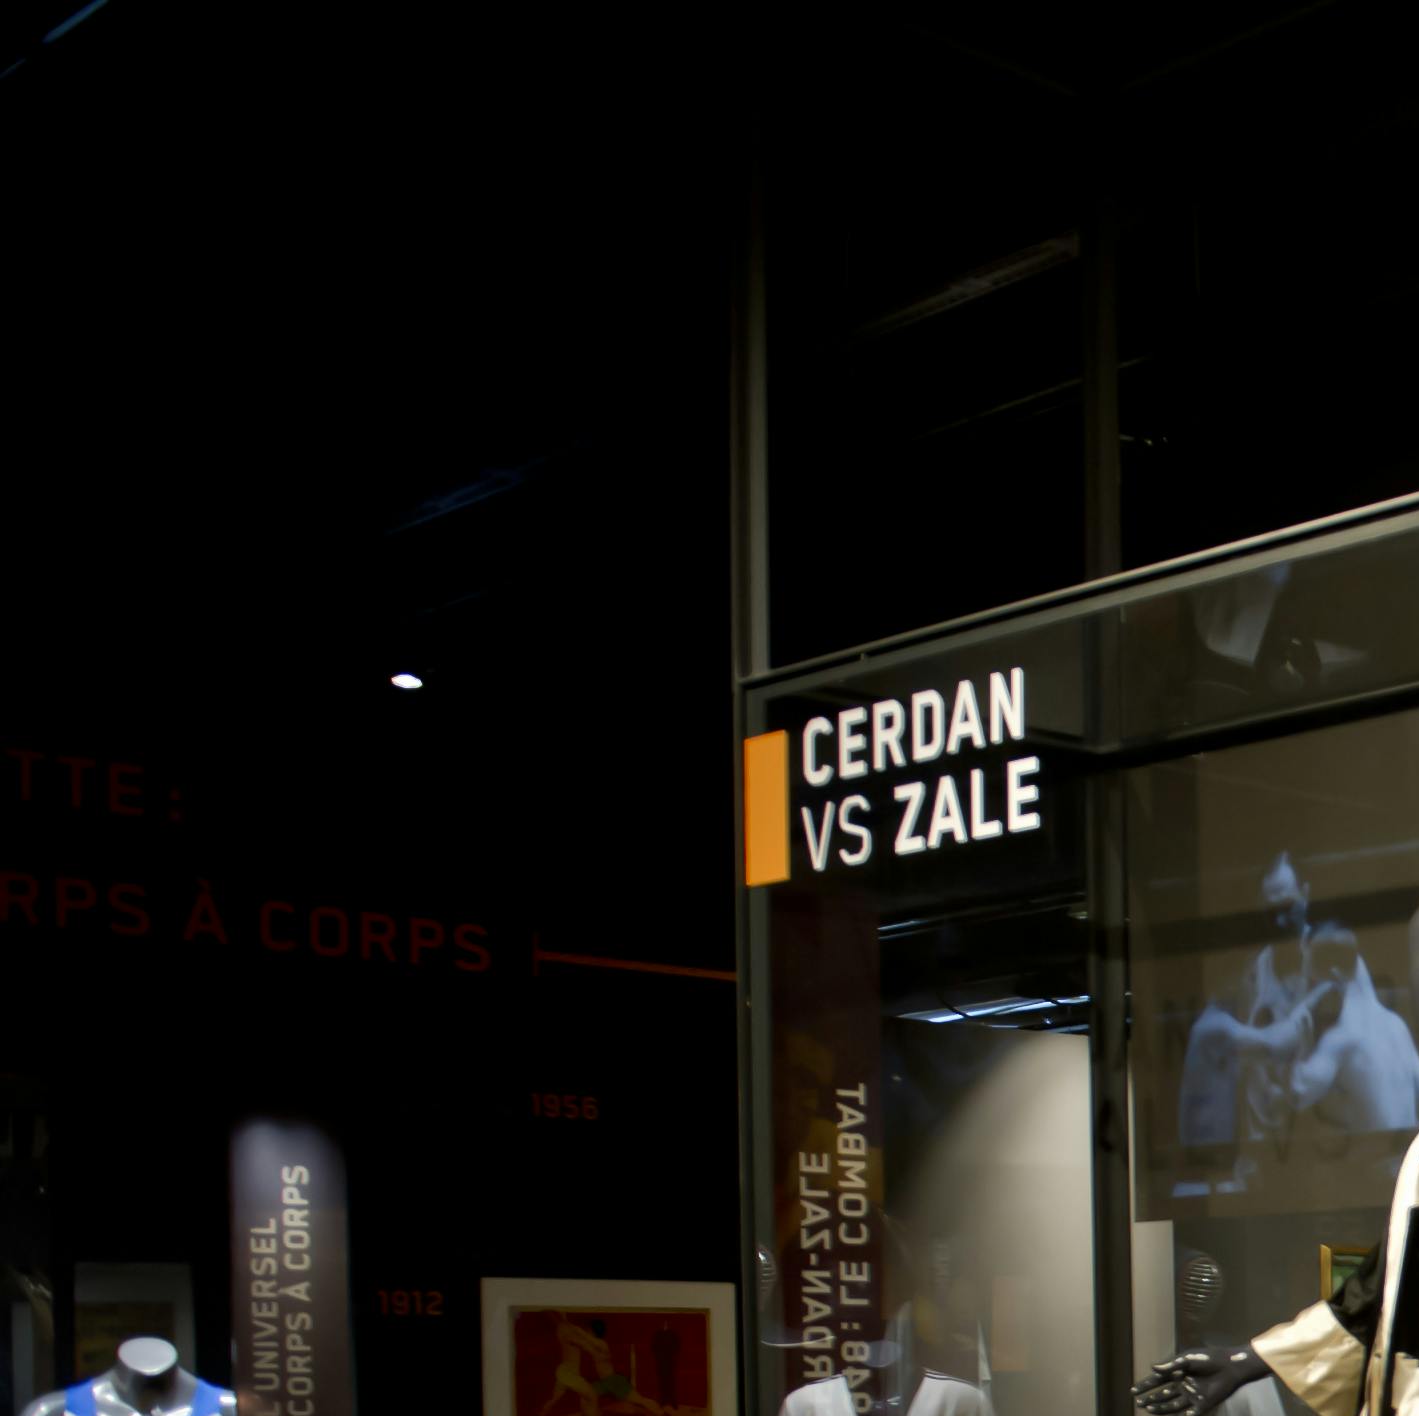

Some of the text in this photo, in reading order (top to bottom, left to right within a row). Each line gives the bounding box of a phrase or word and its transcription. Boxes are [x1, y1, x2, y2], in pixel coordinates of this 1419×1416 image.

[802, 666, 1025, 788] CERDAN
[801, 755, 1041, 873] VS ZALE
[183, 876, 230, 946] À
[259, 900, 493, 976] CORPS
[530, 1092, 600, 1121] 1956
[282, 1165, 310, 1271] CORPS
[280, 1281, 312, 1302] À
[375, 1289, 444, 1319] 1912
